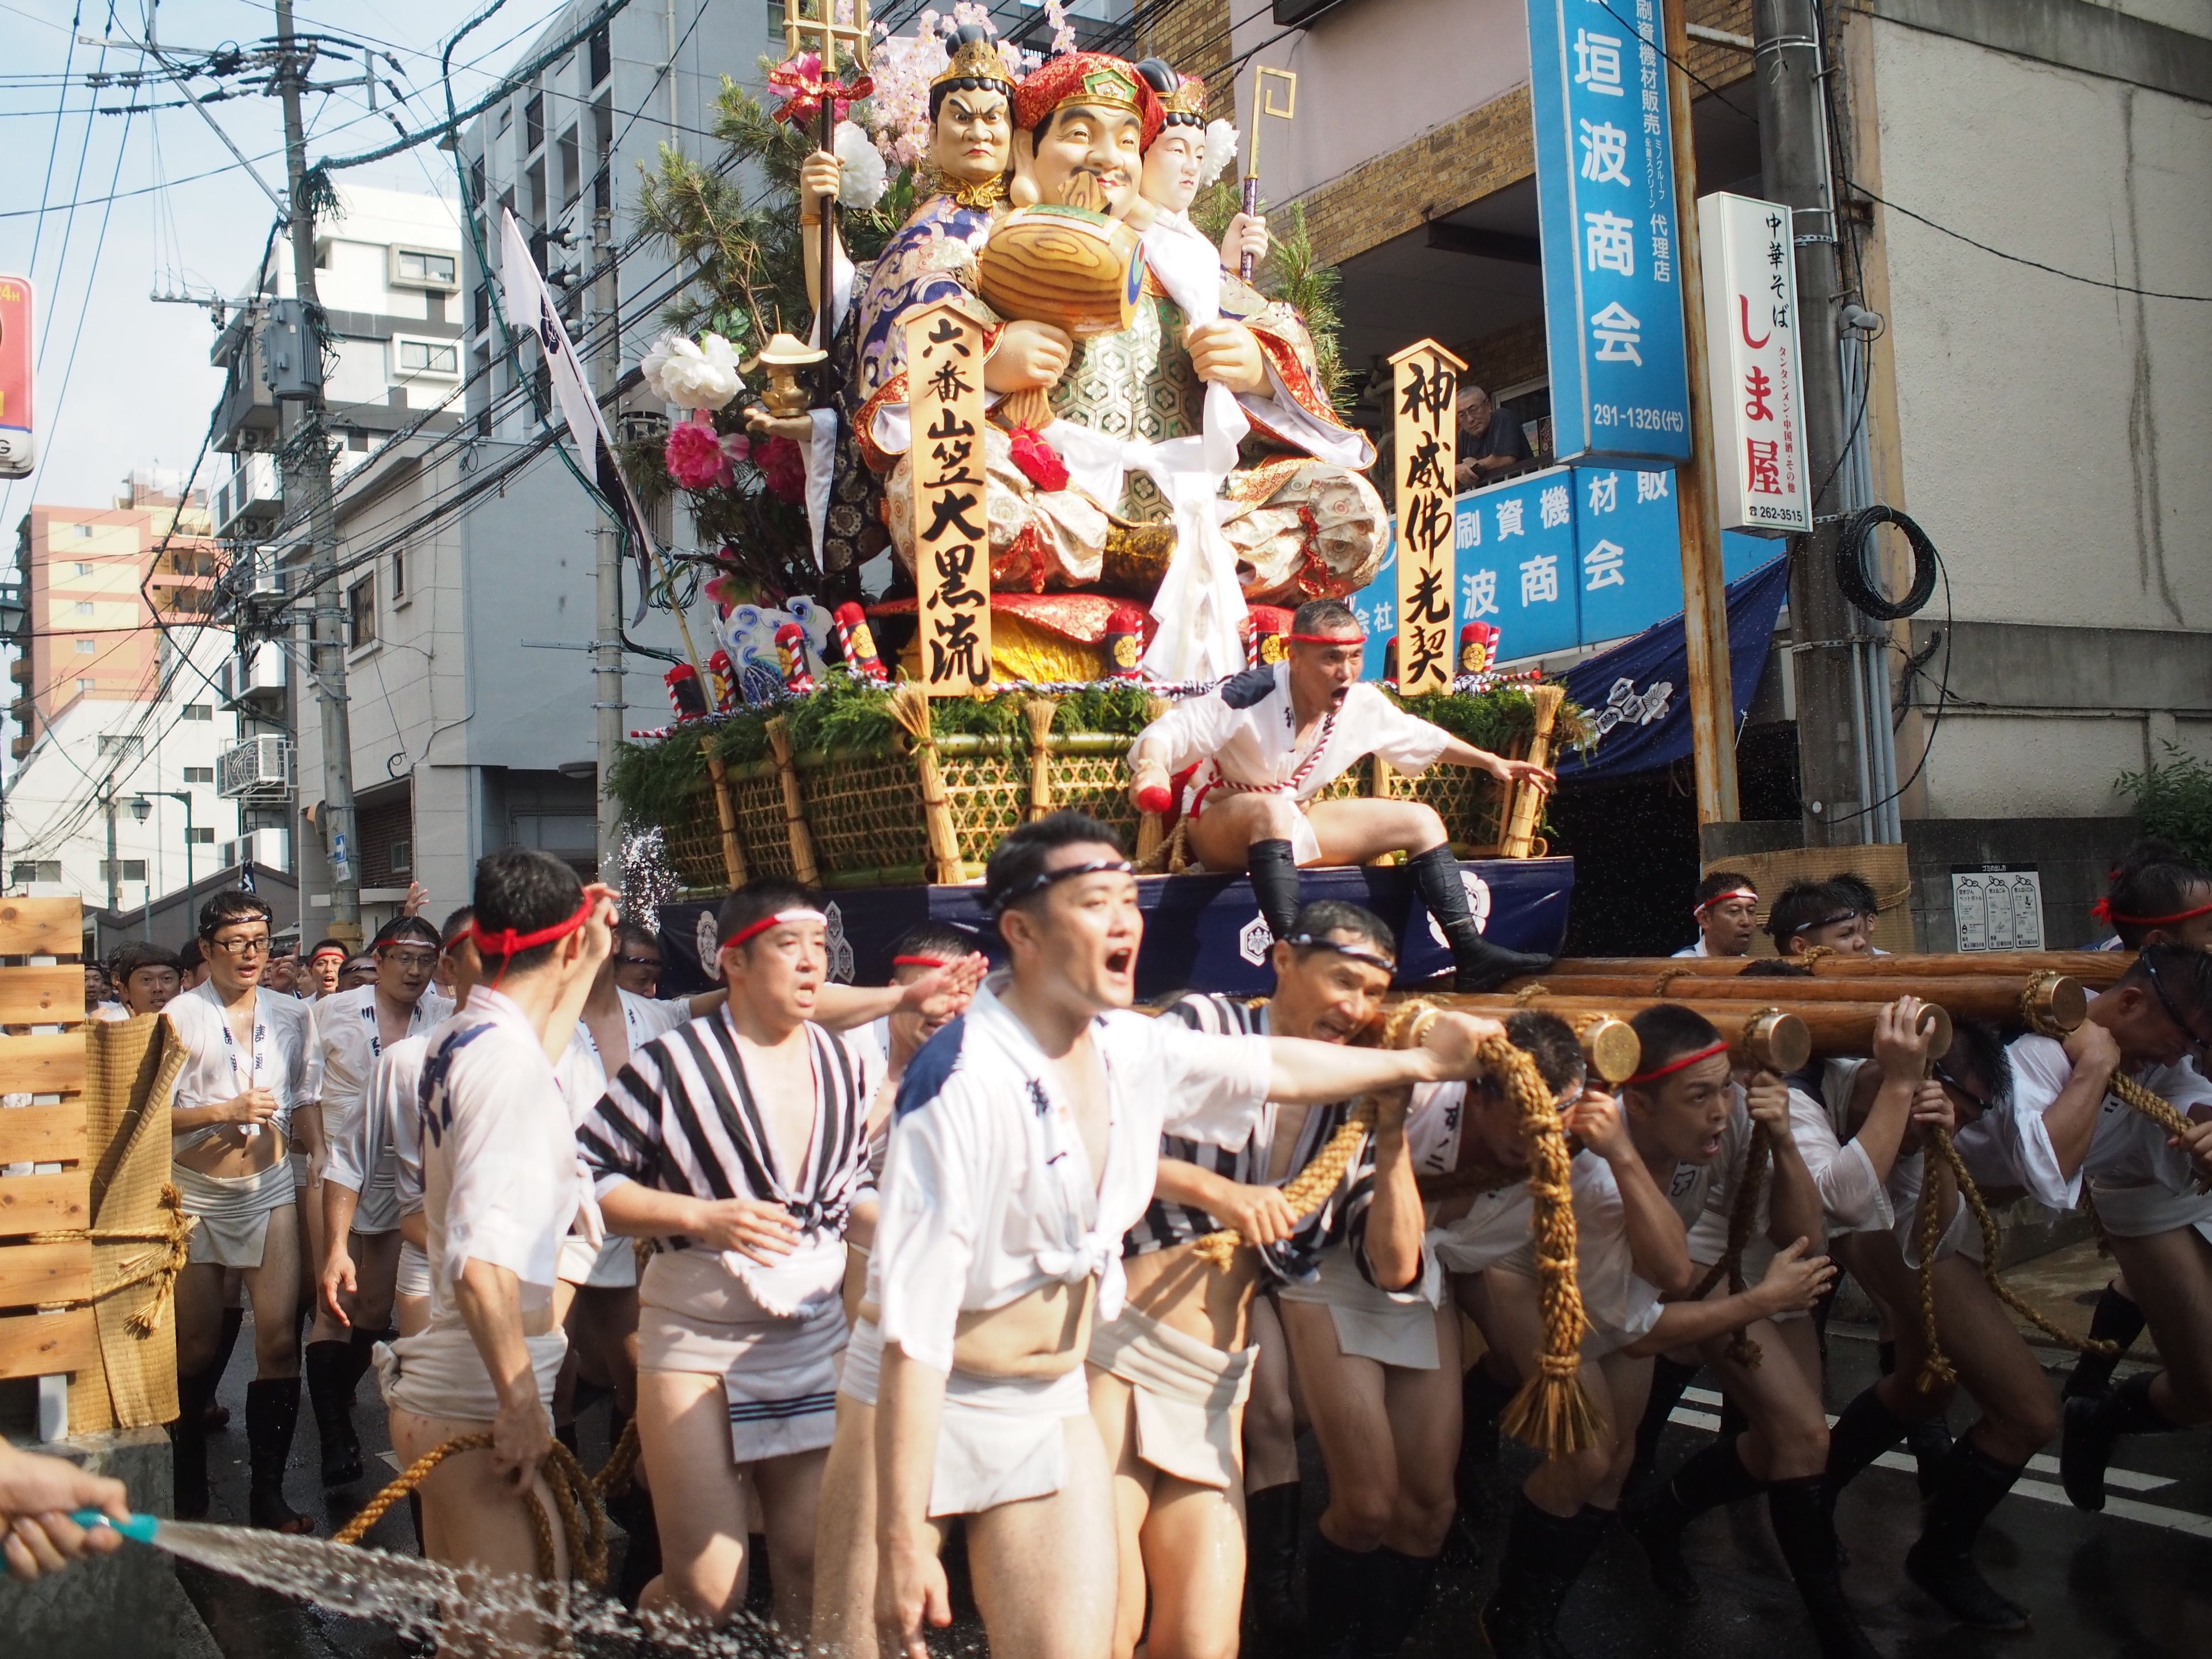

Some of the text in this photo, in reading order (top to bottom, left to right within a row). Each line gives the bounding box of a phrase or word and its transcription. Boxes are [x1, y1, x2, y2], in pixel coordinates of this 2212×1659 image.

[1650, 213, 1671, 283] 代理店
[1766, 212, 1789, 328] 中華そば
[0, 285, 20, 302] 4H
[1593, 403, 1684, 433] 291-1326(代)
[1738, 294, 1783, 495] しま屋
[921, 317, 991, 686] 六番山笠大黒流
[1760, 506, 1803, 522] 262-3515
